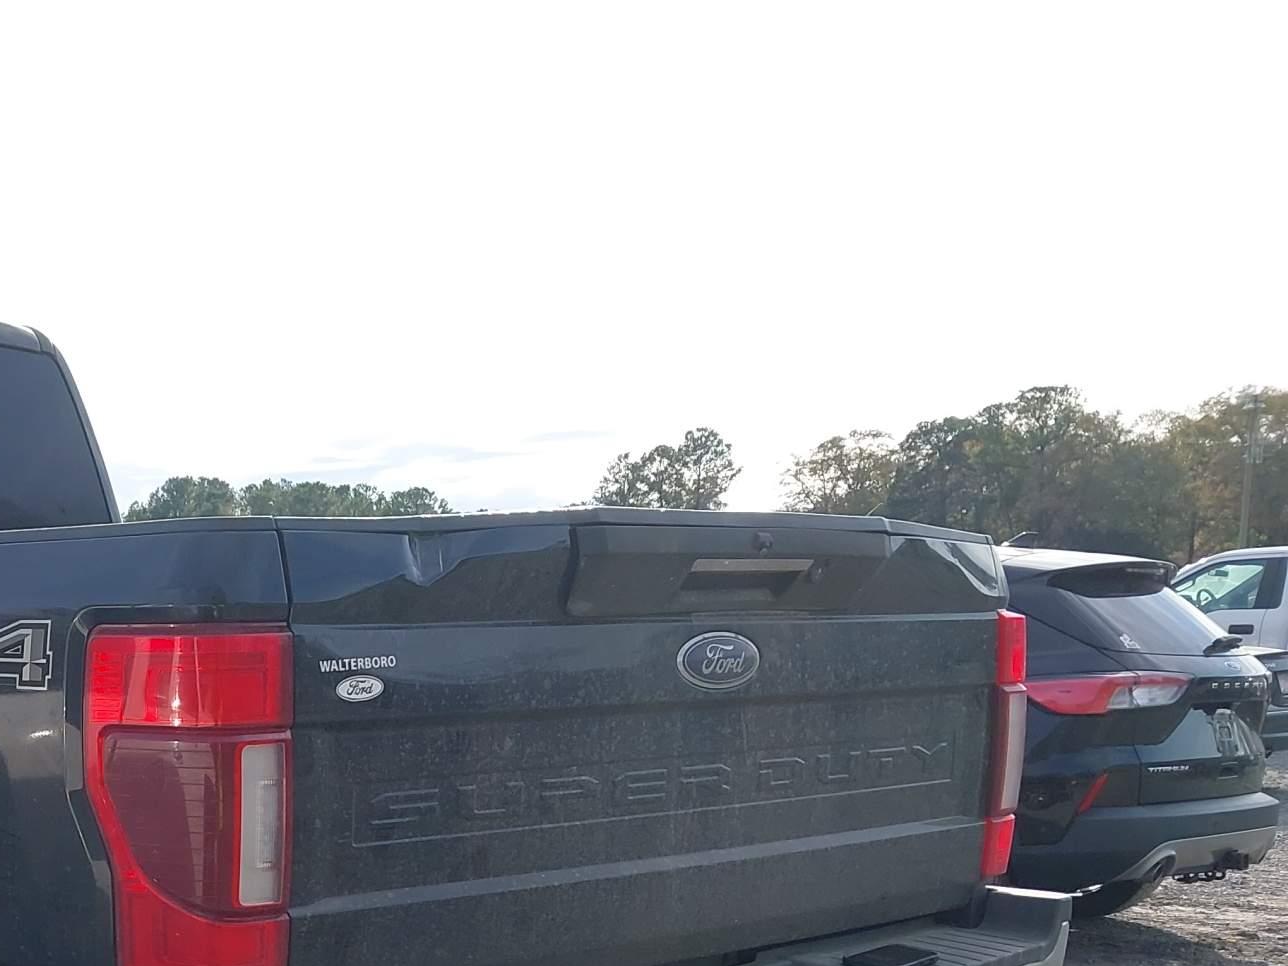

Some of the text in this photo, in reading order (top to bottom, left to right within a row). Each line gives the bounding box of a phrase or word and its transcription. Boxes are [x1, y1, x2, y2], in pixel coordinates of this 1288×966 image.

[319, 655, 396, 673] WALTERBORO
[702, 643, 745, 674] Ford
[346, 679, 373, 696] Ford
[368, 742, 949, 830] SUPER DUTY
